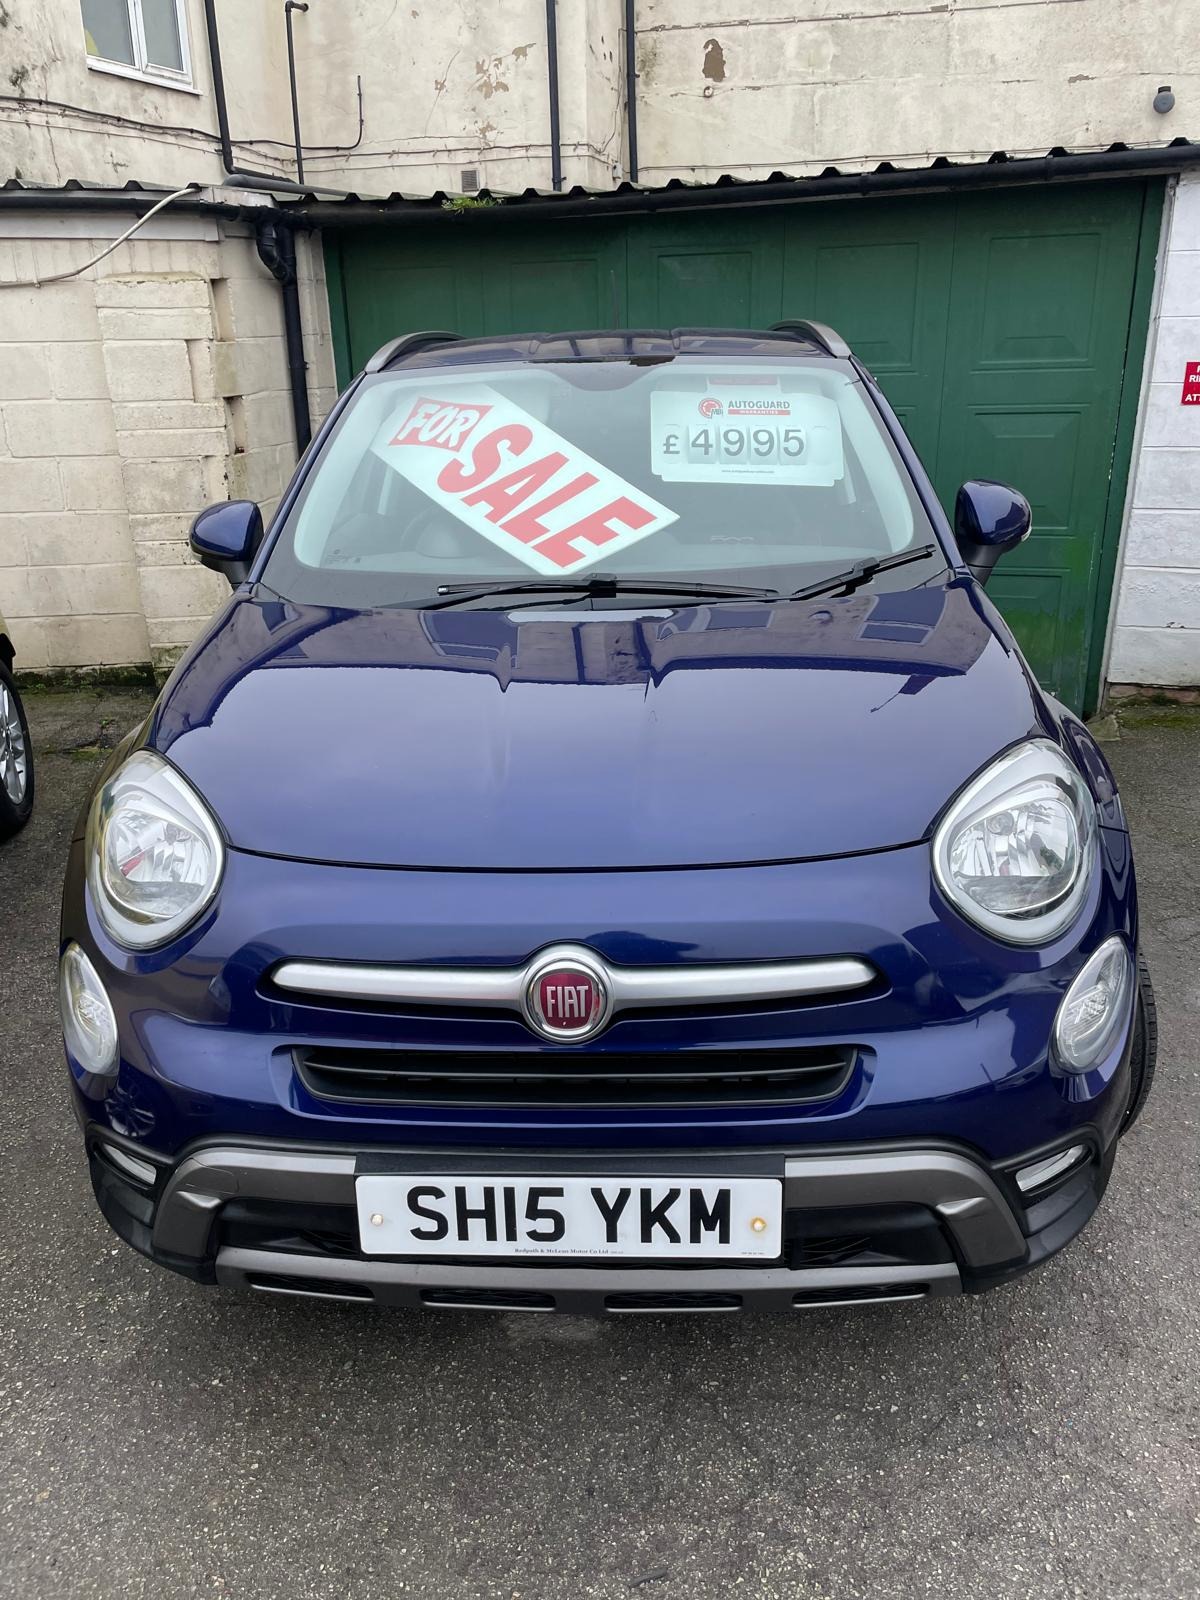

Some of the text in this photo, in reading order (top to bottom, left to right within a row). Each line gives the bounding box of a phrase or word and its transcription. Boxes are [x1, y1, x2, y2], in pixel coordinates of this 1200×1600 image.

[728, 400, 790, 409] AUTOGUARD
[395, 402, 658, 568] FOR SALE
[546, 985, 589, 1018] FIAT
[406, 1185, 731, 1245] SH15 YKM
